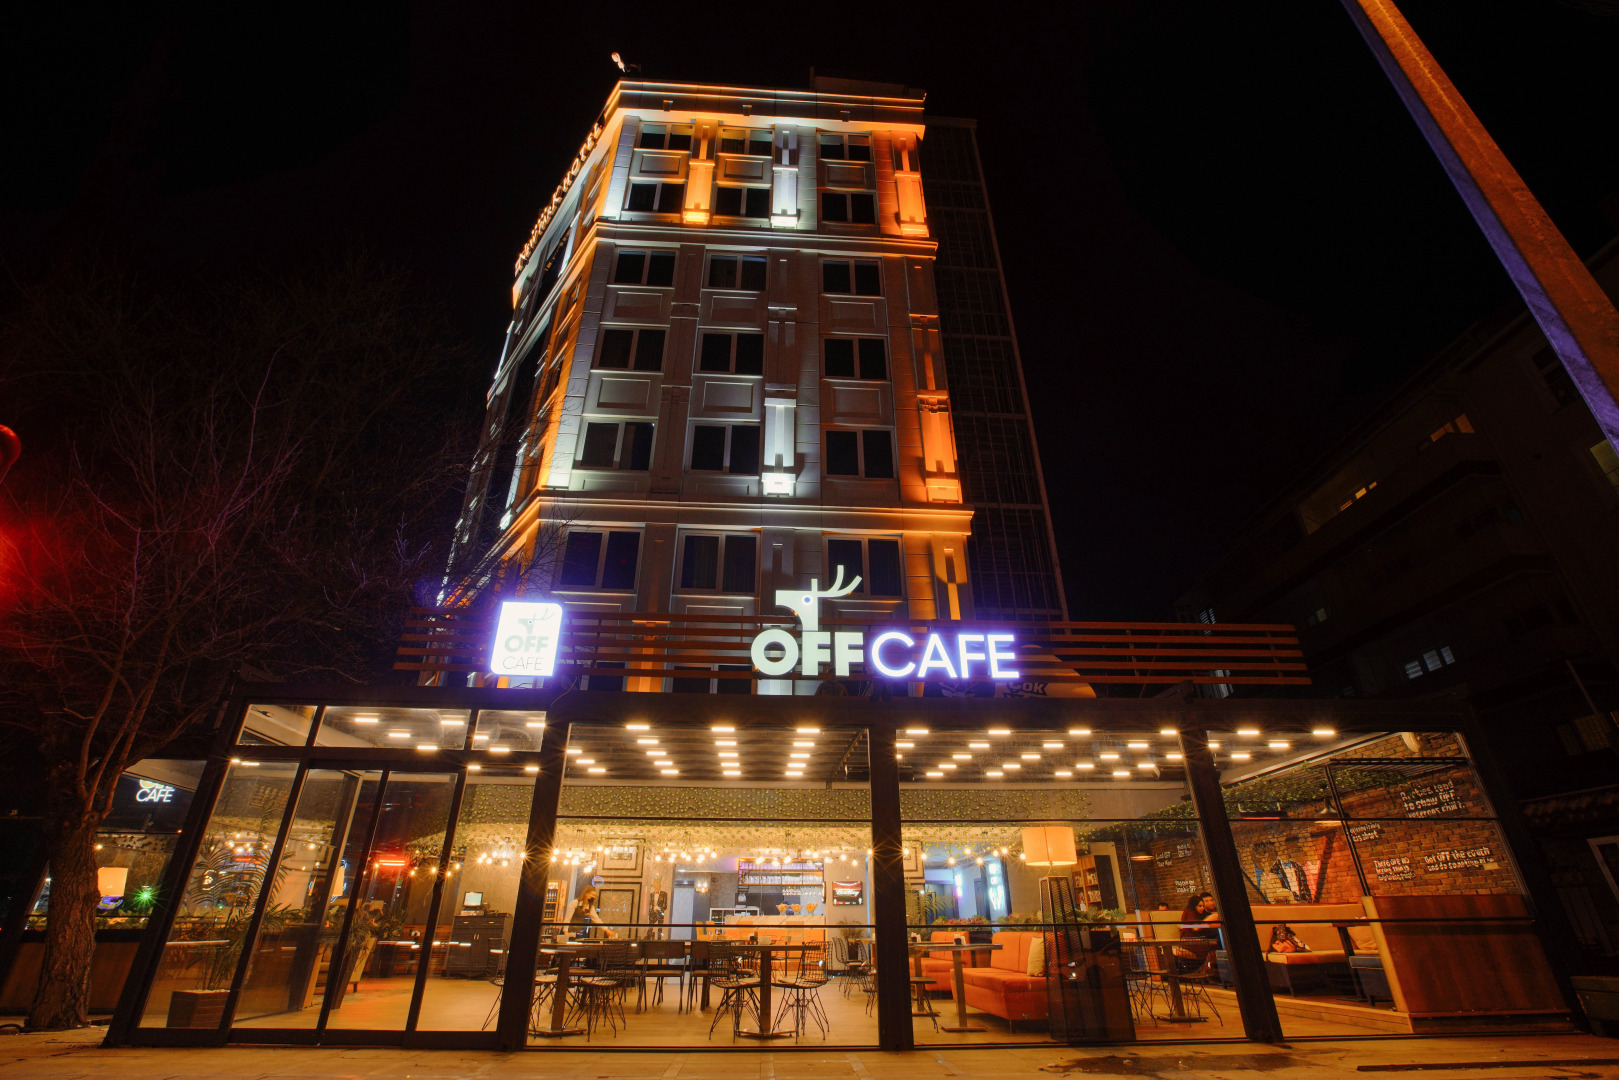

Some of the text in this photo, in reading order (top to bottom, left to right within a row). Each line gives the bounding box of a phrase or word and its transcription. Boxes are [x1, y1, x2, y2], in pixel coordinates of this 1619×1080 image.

[562, 123, 602, 192] HOTEL
[504, 634, 549, 653] OFF
[750, 629, 1020, 678] OFF CAFE
[502, 656, 544, 670] CAFE
[136, 788, 175, 802] CAFE
[1404, 801, 1415, 811] to
[1415, 797, 1438, 809] show
[1436, 851, 1450, 861] OFF
[1451, 850, 1466, 860] the
[1467, 846, 1491, 858] couch
